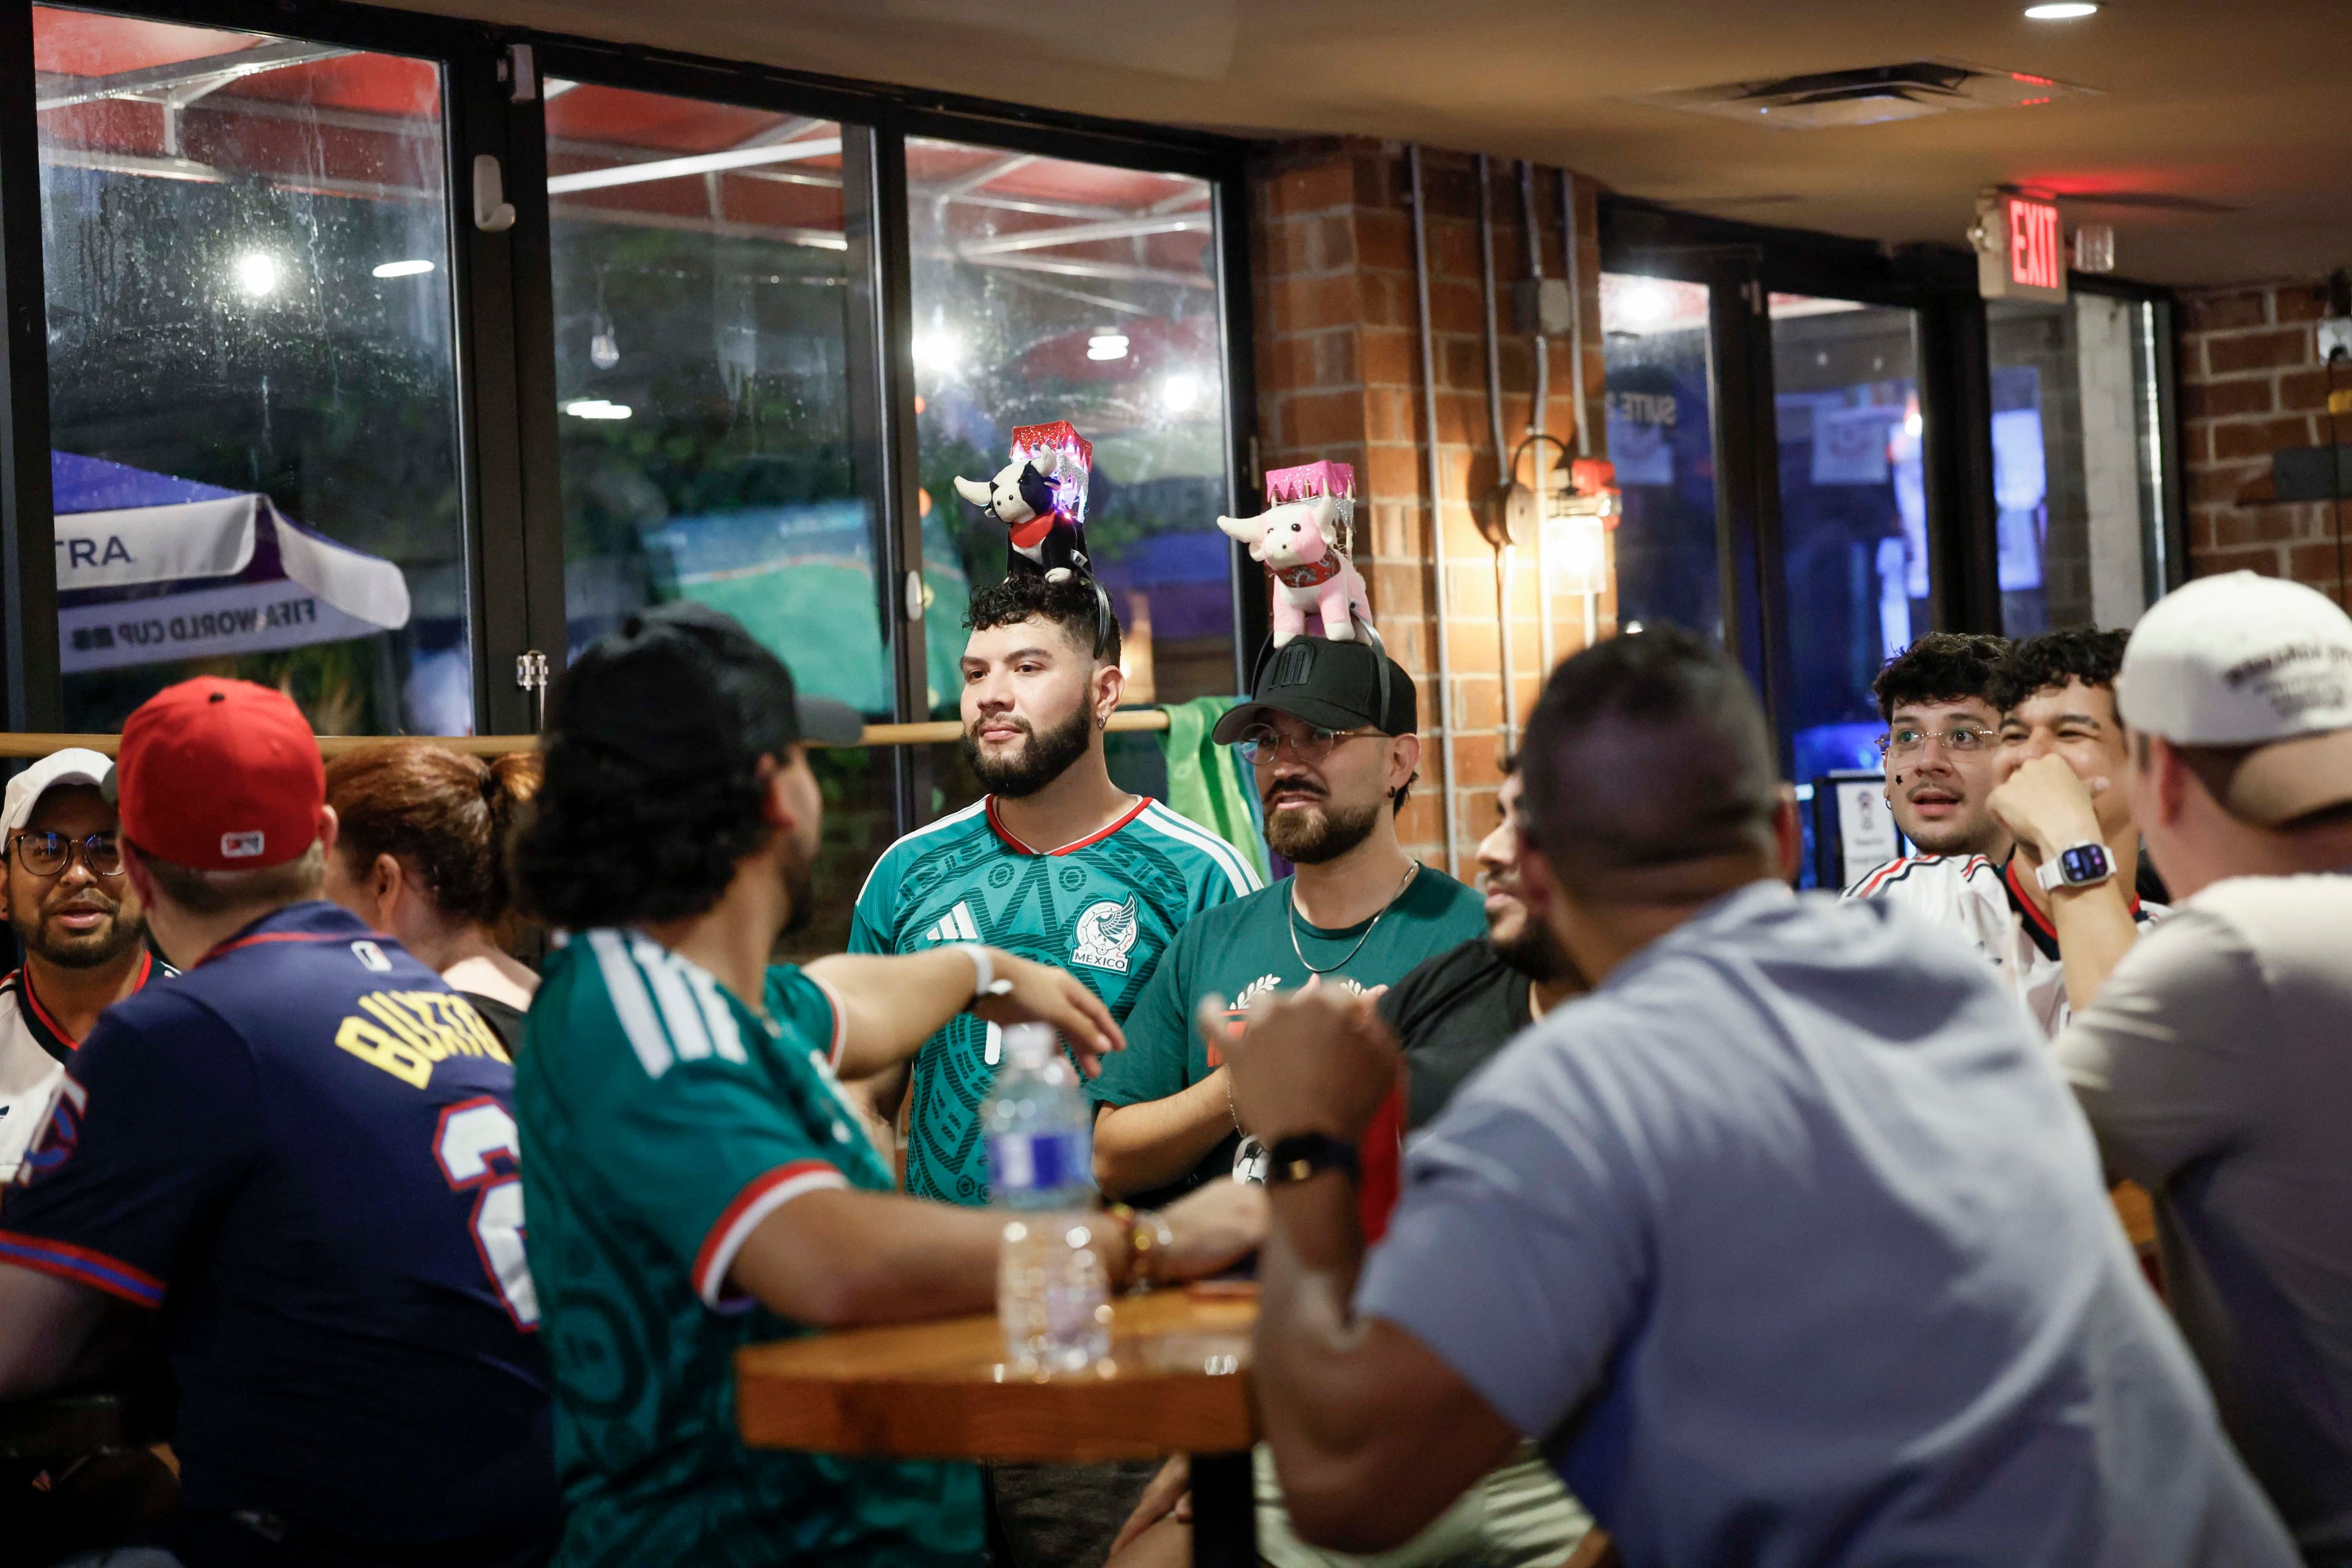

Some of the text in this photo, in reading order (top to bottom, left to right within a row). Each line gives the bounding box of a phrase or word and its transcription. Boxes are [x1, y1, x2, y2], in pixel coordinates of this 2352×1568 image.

[2010, 200, 2058, 288] EXIT
[56, 535, 132, 568] RA
[1075, 952, 1125, 969] MÉXICO
